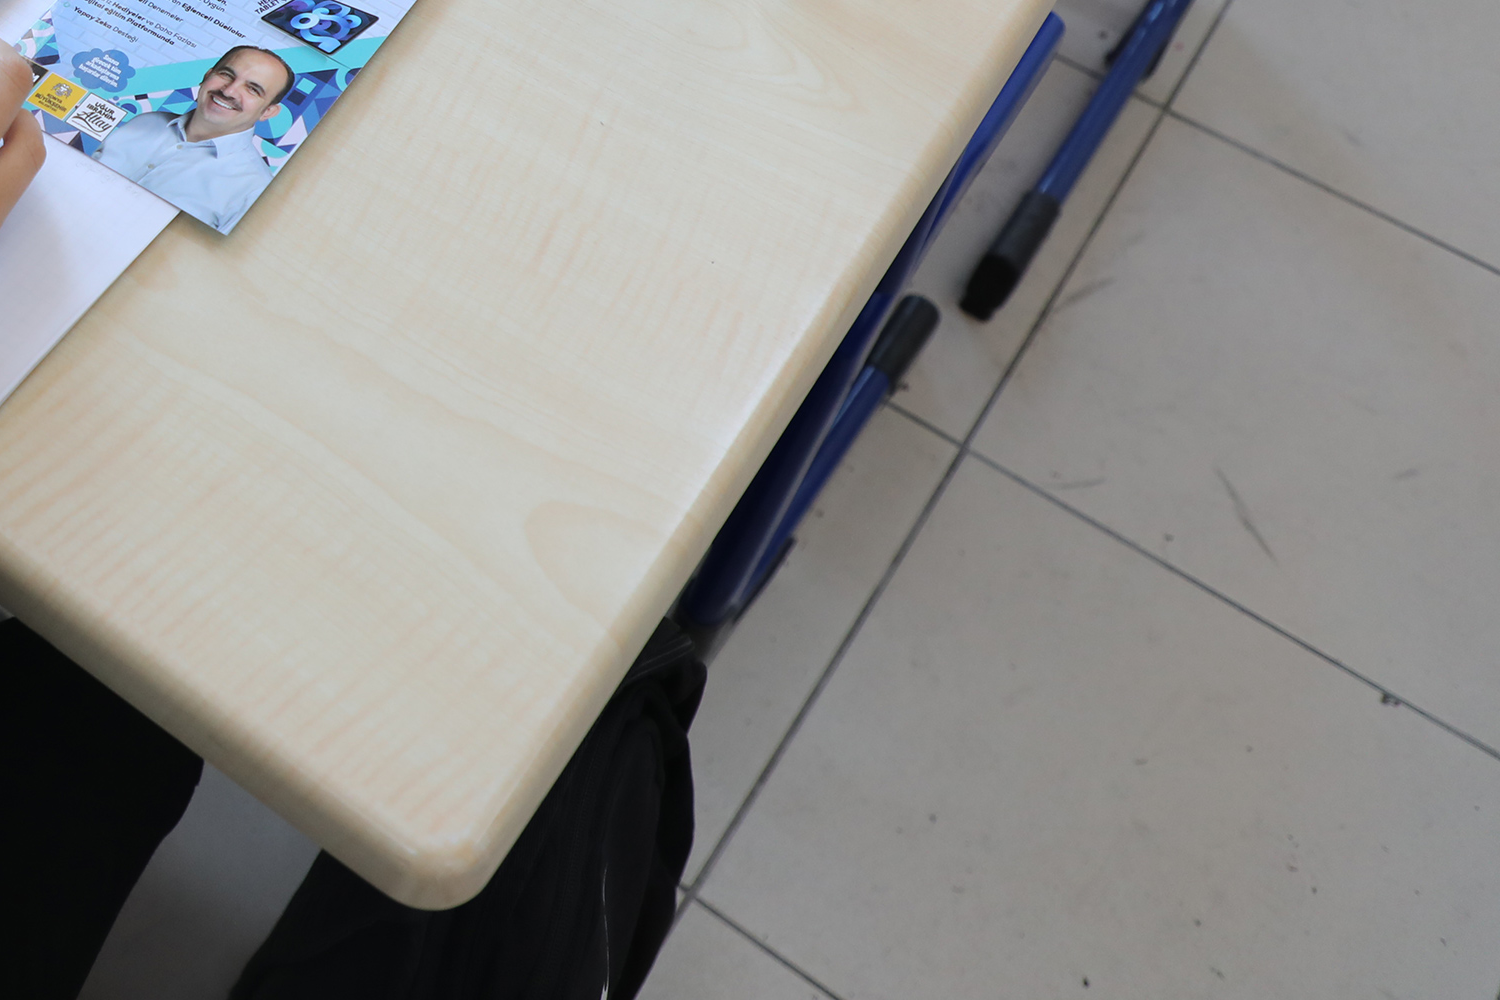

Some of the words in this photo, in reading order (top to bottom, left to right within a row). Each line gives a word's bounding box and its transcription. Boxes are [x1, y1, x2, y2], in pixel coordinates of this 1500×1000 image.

[147, 1, 183, 22] Denemeler
[181, 2, 214, 21] Eğlenceli
[213, 18, 246, 38] Düellolar
[254, 0, 280, 14] TABLET
[74, 6, 95, 20] Yapay
[94, 17, 112, 29] Zeka
[112, 26, 139, 43] Desteği
[112, 2, 145, 21] Hediyeler
[154, 23, 173, 36] Daha
[172, 32, 197, 48] Fazlası
[126, 17, 175, 45] Platformunda
[95, 101, 115, 115] UĞUR
